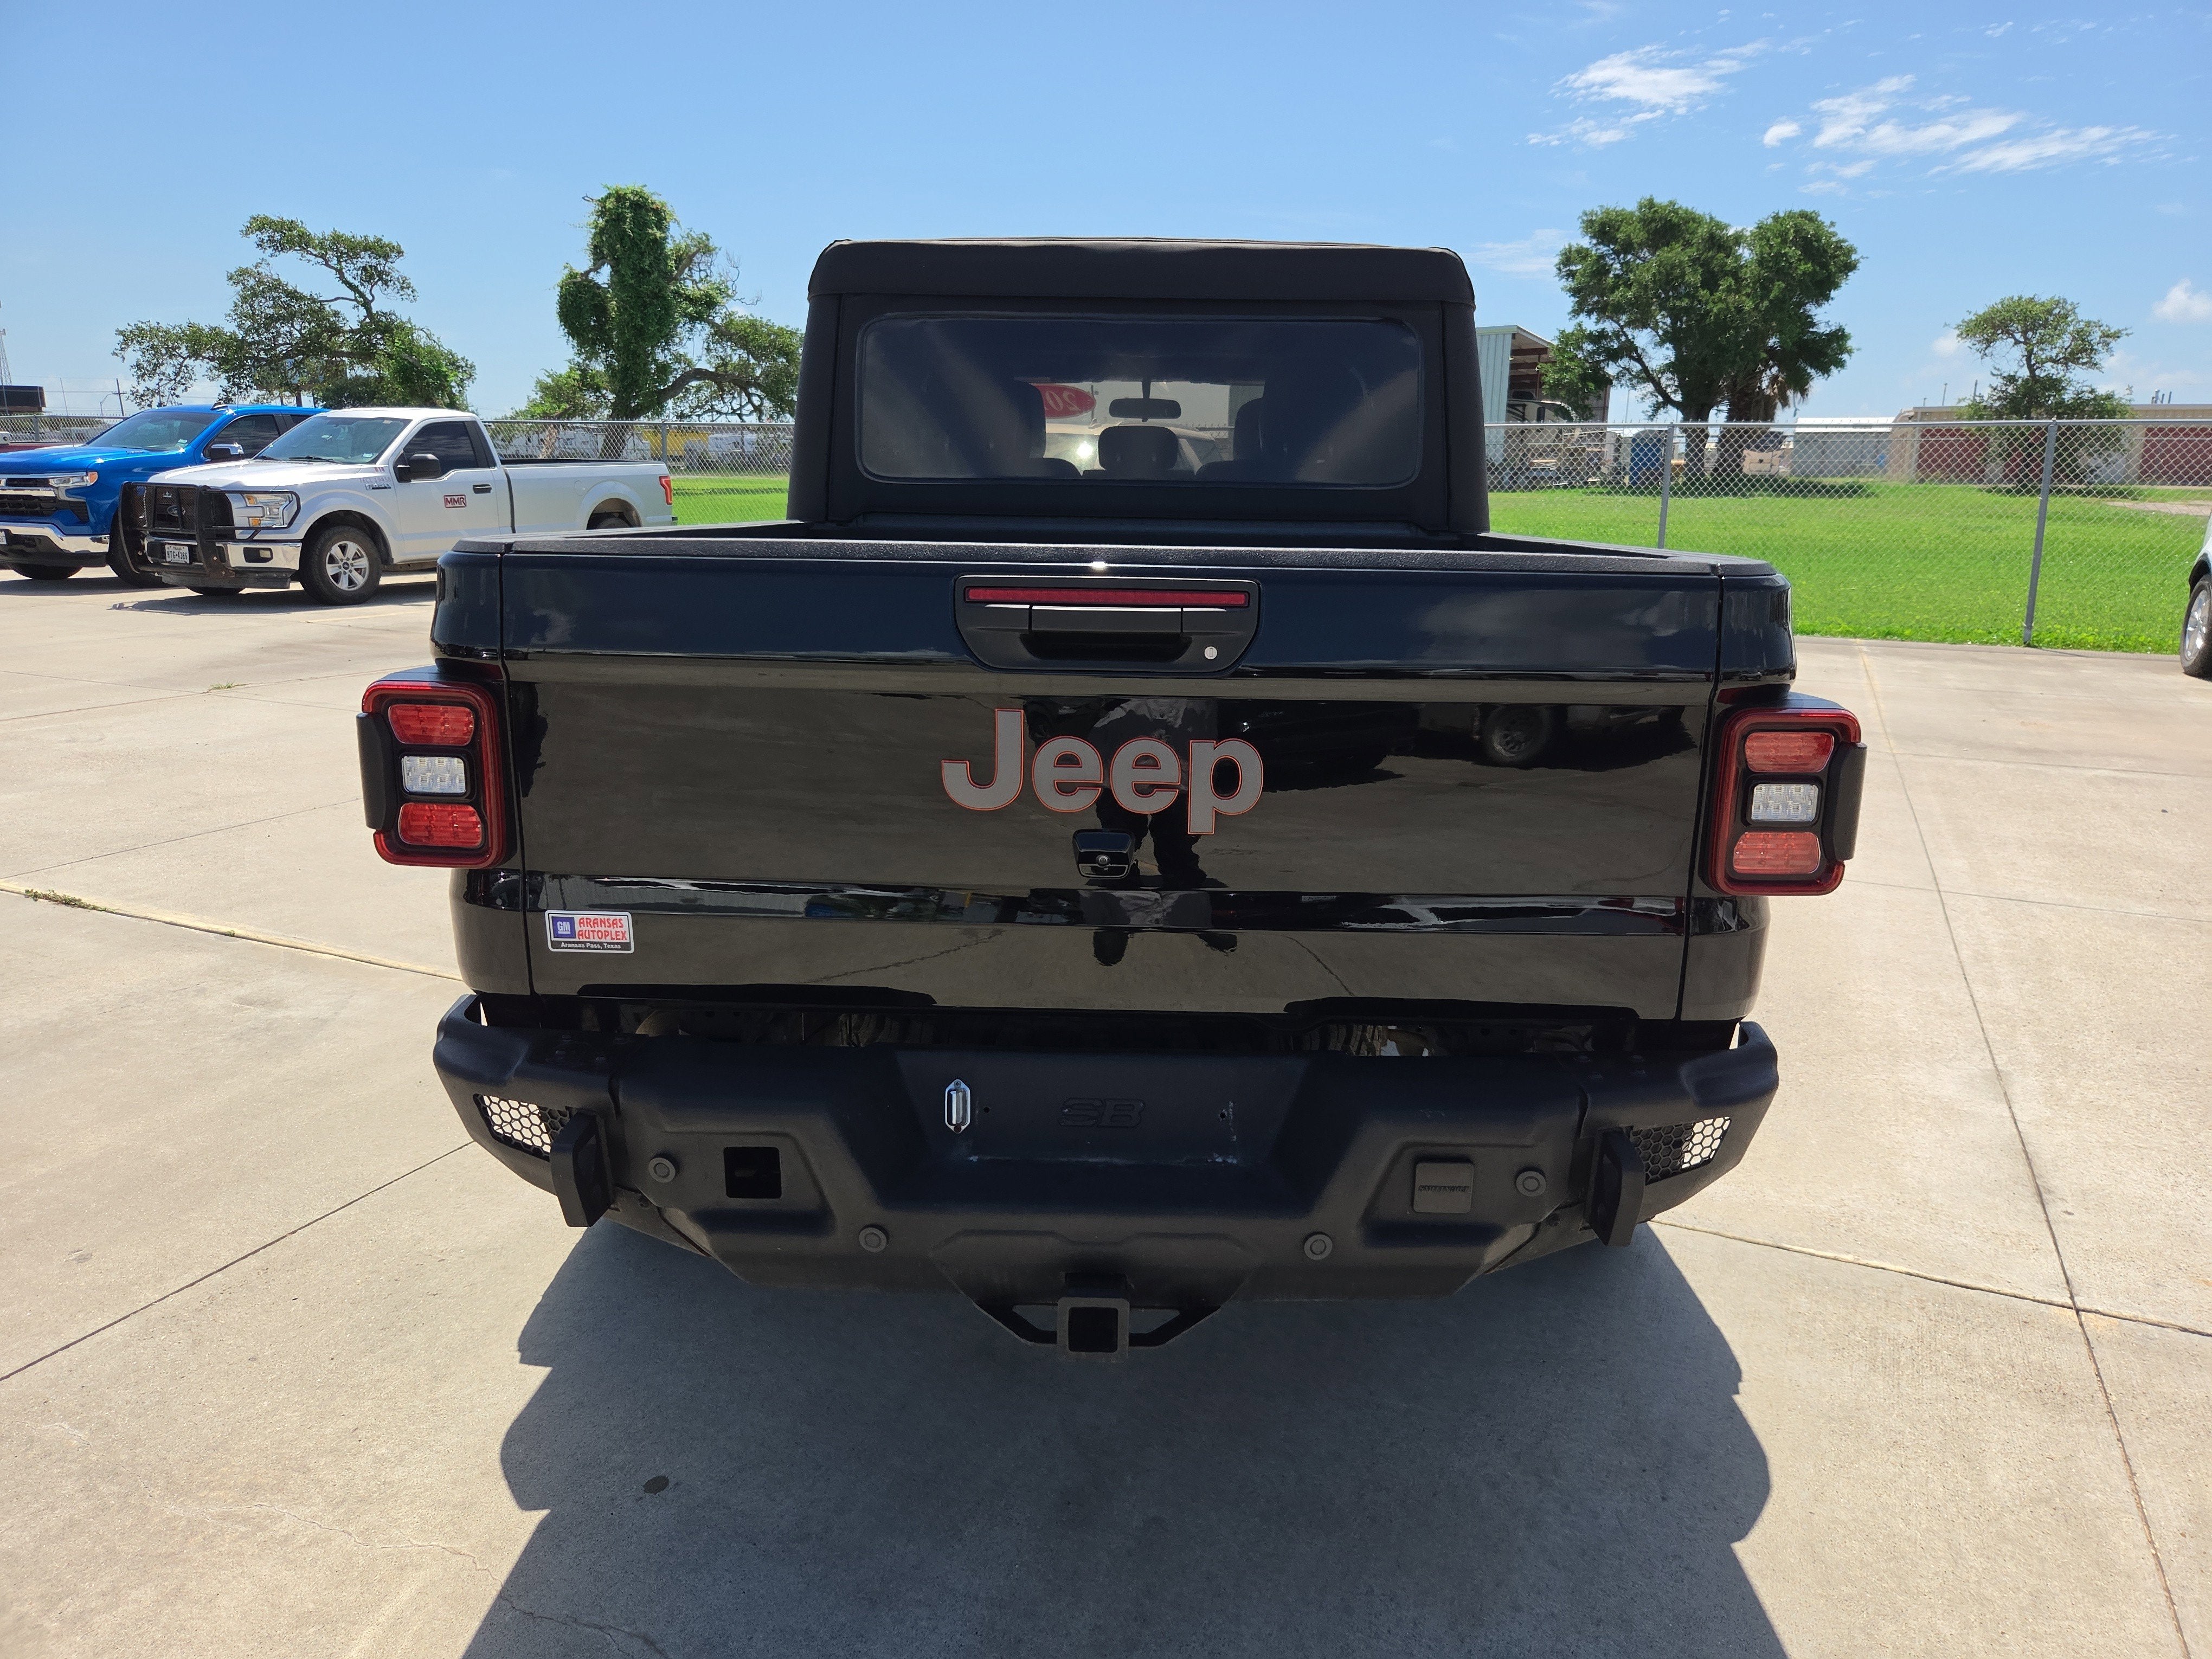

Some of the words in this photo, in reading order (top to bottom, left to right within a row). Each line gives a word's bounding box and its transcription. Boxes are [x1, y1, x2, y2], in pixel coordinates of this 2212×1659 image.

[446, 497, 466, 506] MMR
[941, 708, 1264, 835] Jeep
[557, 921, 571, 933] GM
[578, 917, 625, 929] ARANSAS
[577, 930, 628, 941] AUTOPLEX
[1057, 1097, 1146, 1128] SB
